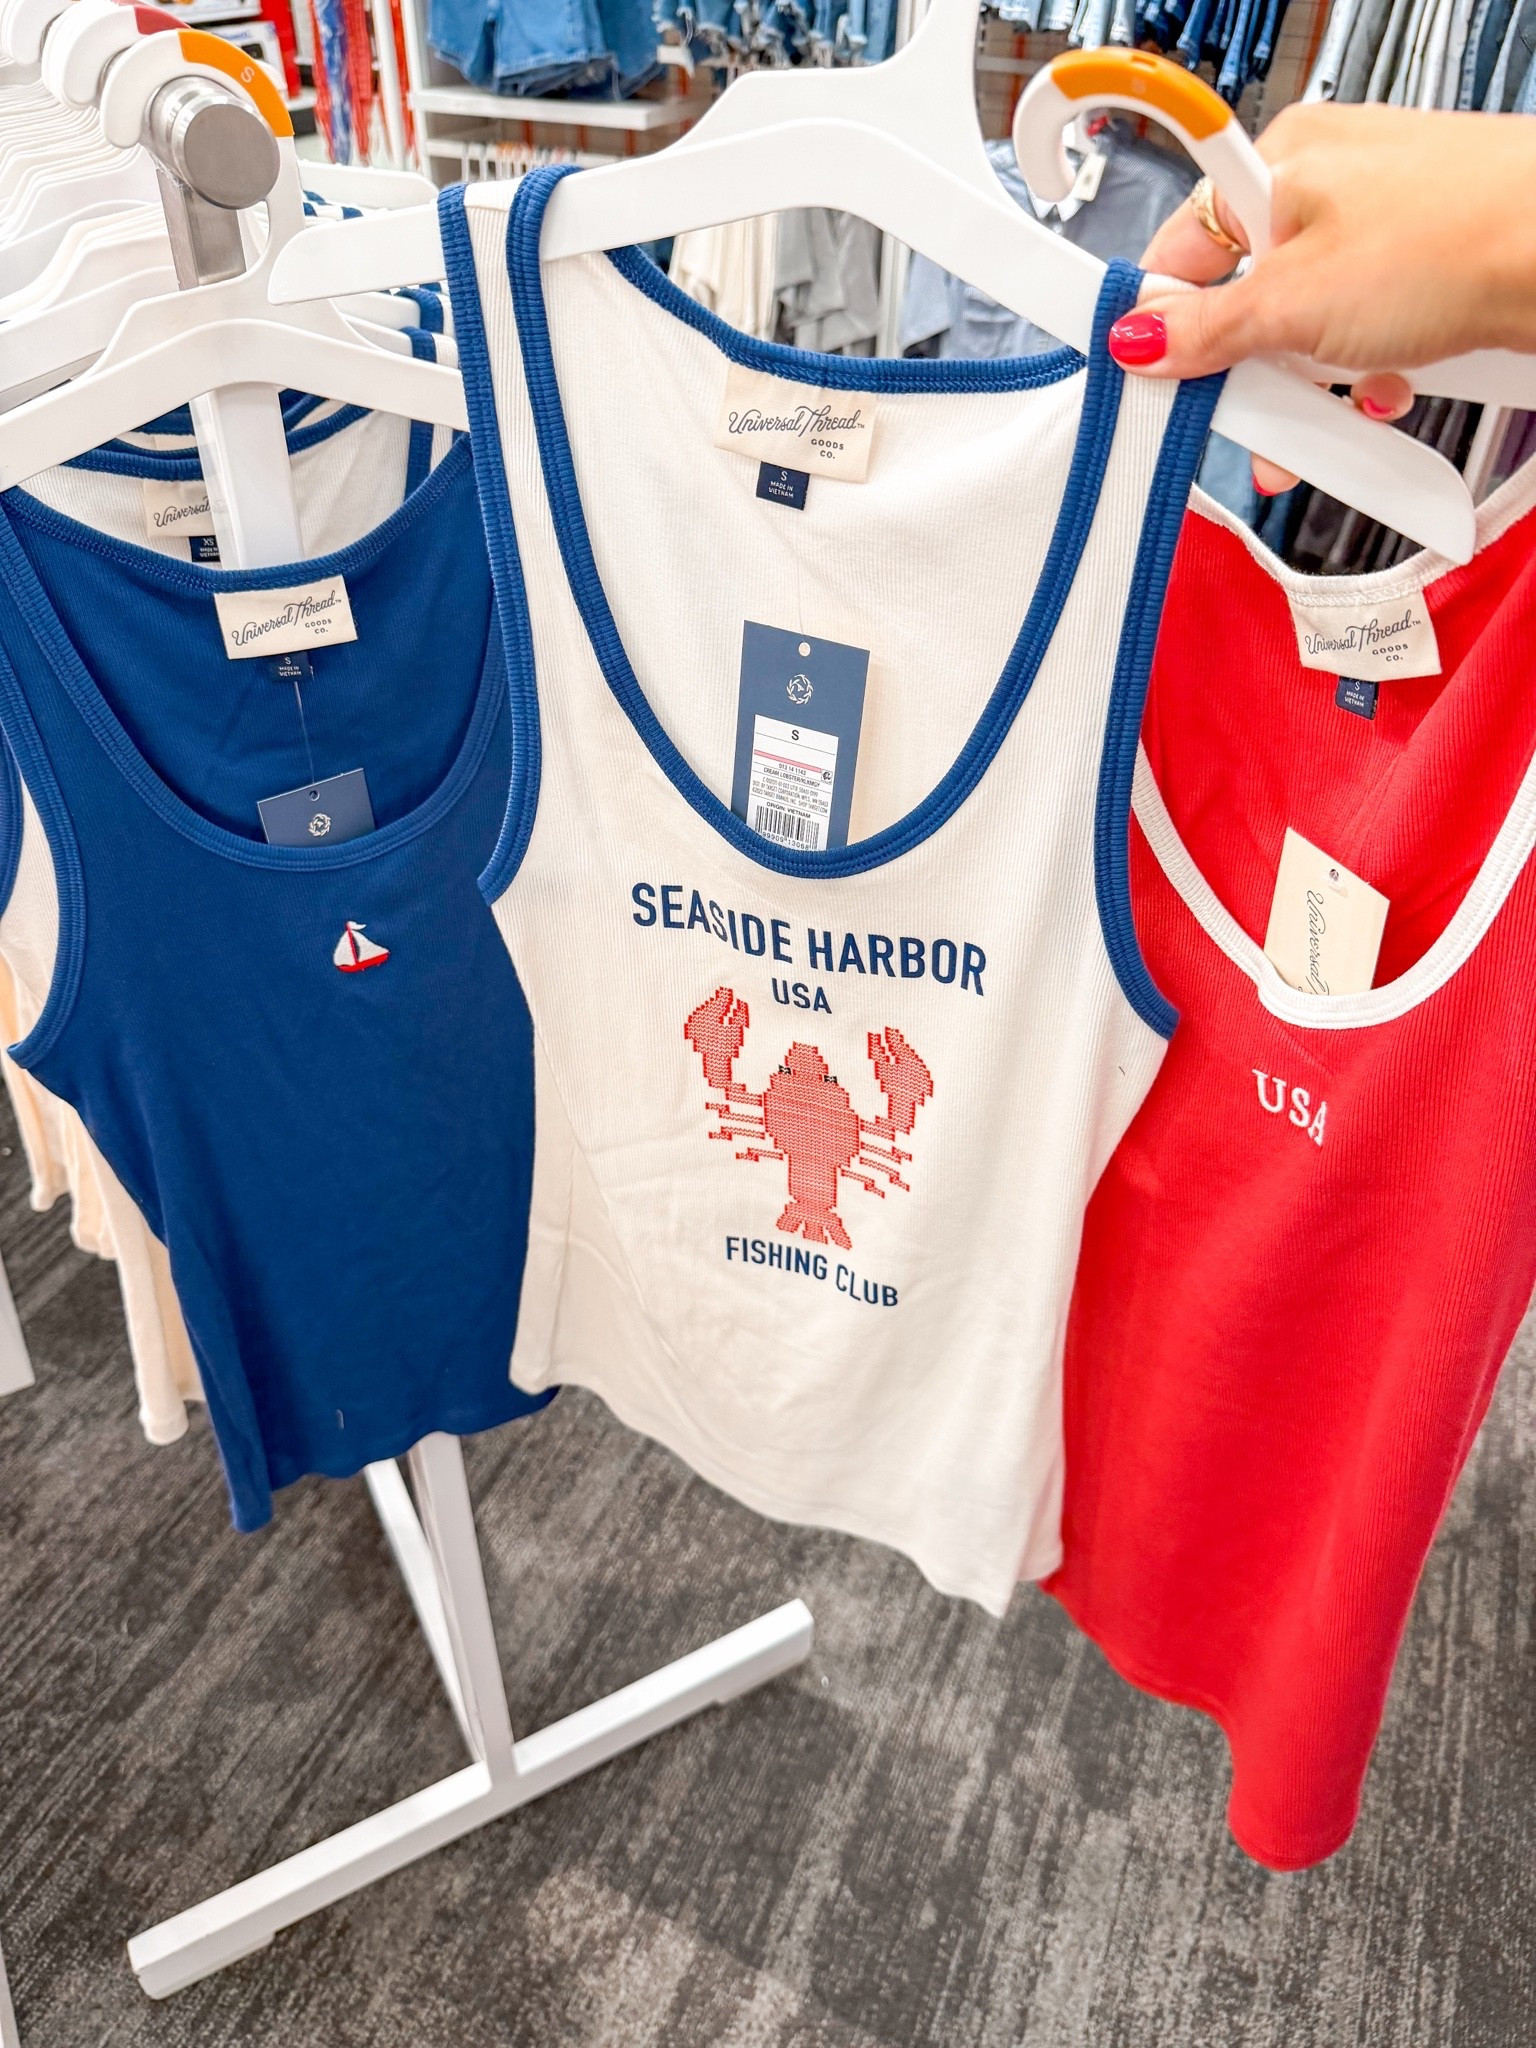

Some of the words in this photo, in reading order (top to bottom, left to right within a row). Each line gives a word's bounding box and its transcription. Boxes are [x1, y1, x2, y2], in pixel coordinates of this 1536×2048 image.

[240, 66, 255, 84] S
[729, 409, 801, 434] Universal
[811, 439, 844, 450] GOODS
[820, 450, 835, 459] CO.
[781, 471, 788, 481] S
[770, 481, 786, 490] MADE
[768, 487, 793, 498] VIETNAM
[153, 499, 211, 528] Universal
[203, 538, 214, 546] XS
[231, 605, 294, 646] Universal
[305, 618, 332, 628] GOODS
[314, 627, 329, 635] CO.
[1305, 630, 1356, 655] Universal
[1372, 644, 1408, 655] GOODS
[285, 657, 291, 665] S
[1355, 682, 1360, 691] S
[1346, 690, 1359, 699] MADE
[1344, 696, 1365, 707] VIETNAM
[792, 730, 799, 740] S
[764, 767, 779, 776] CREAM
[766, 801, 785, 811] ORIGIN:
[787, 808, 810, 818] VIETNAM
[632, 882, 793, 964] SEASIDE
[808, 928, 987, 996] HARBOR
[772, 977, 832, 1014] USA
[1252, 1069, 1328, 1146] USA
[726, 1236, 827, 1280] FISHING
[836, 1264, 899, 1307] CLUB
